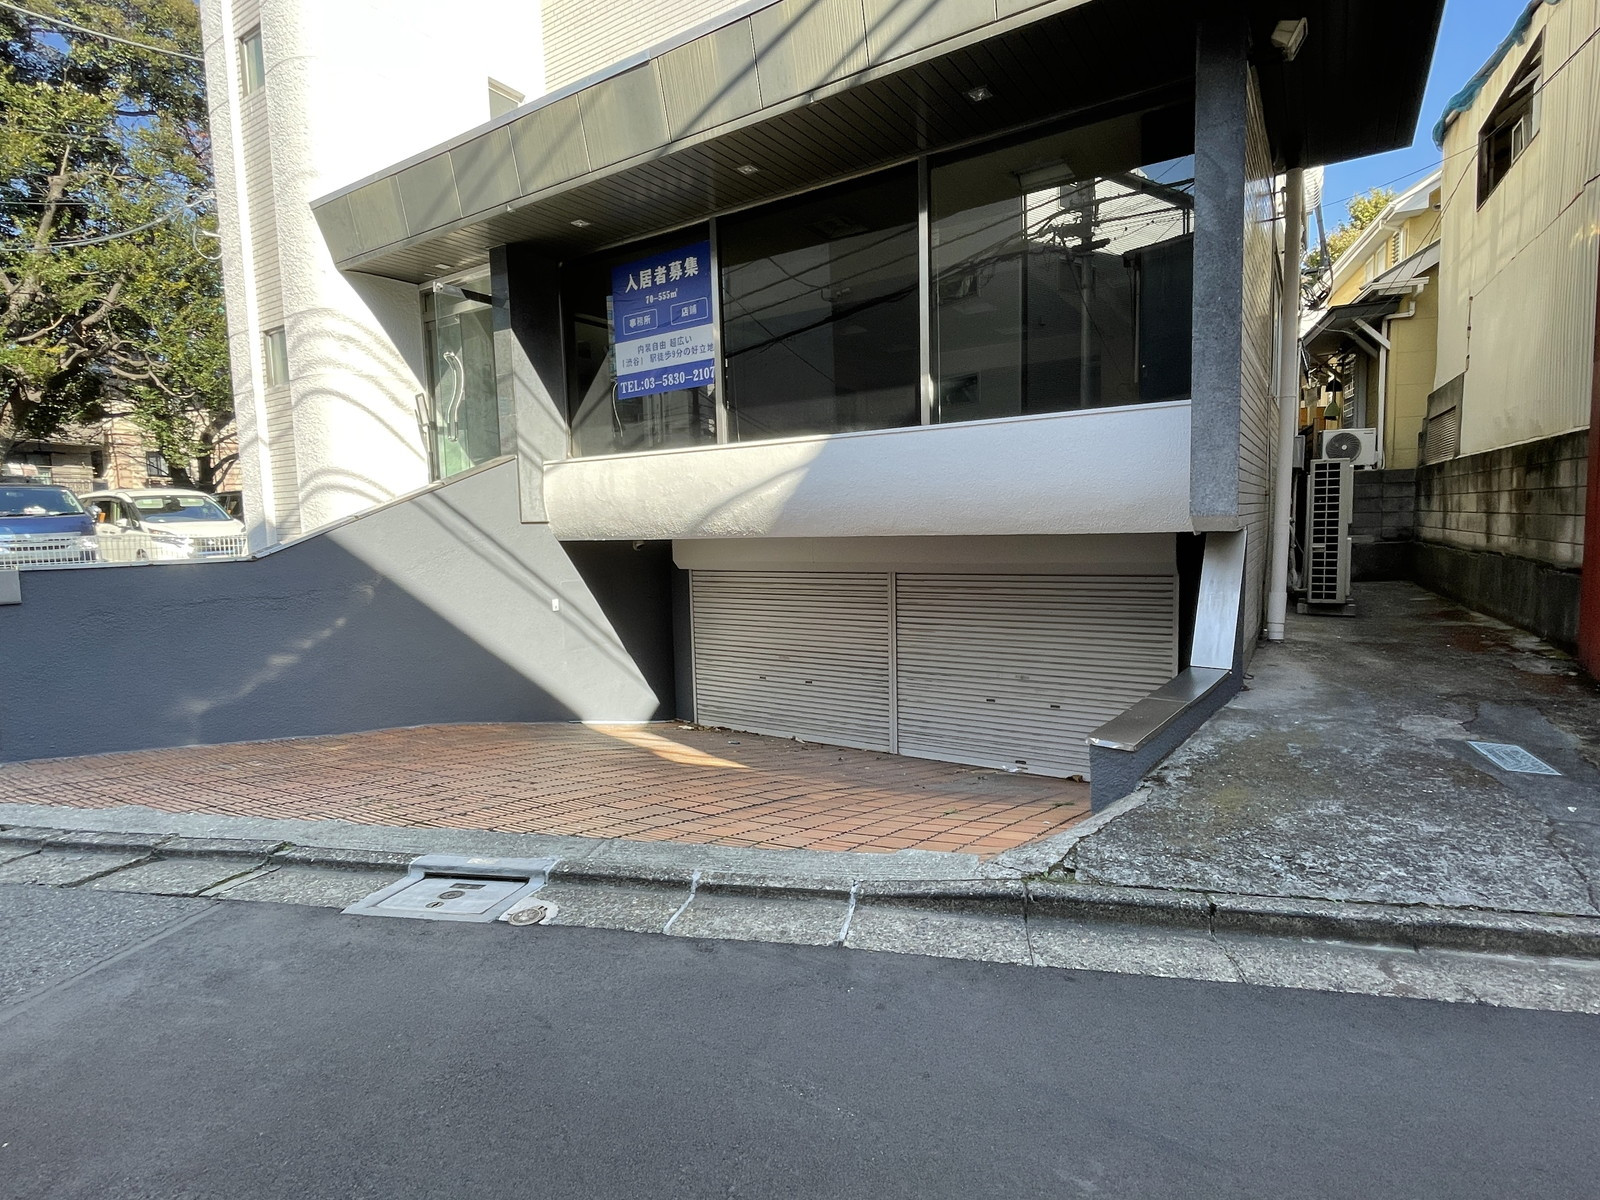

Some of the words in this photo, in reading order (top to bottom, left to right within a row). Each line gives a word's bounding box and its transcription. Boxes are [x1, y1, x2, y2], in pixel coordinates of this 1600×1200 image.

[625, 256, 698, 293] 入居者募集
[681, 304, 697, 317] 店舗
[629, 314, 651, 328] 事務所
[637, 340, 666, 354] 内装自由
[669, 335, 692, 347] 超広い
[620, 366, 715, 394] TEL:03-5830-2107
